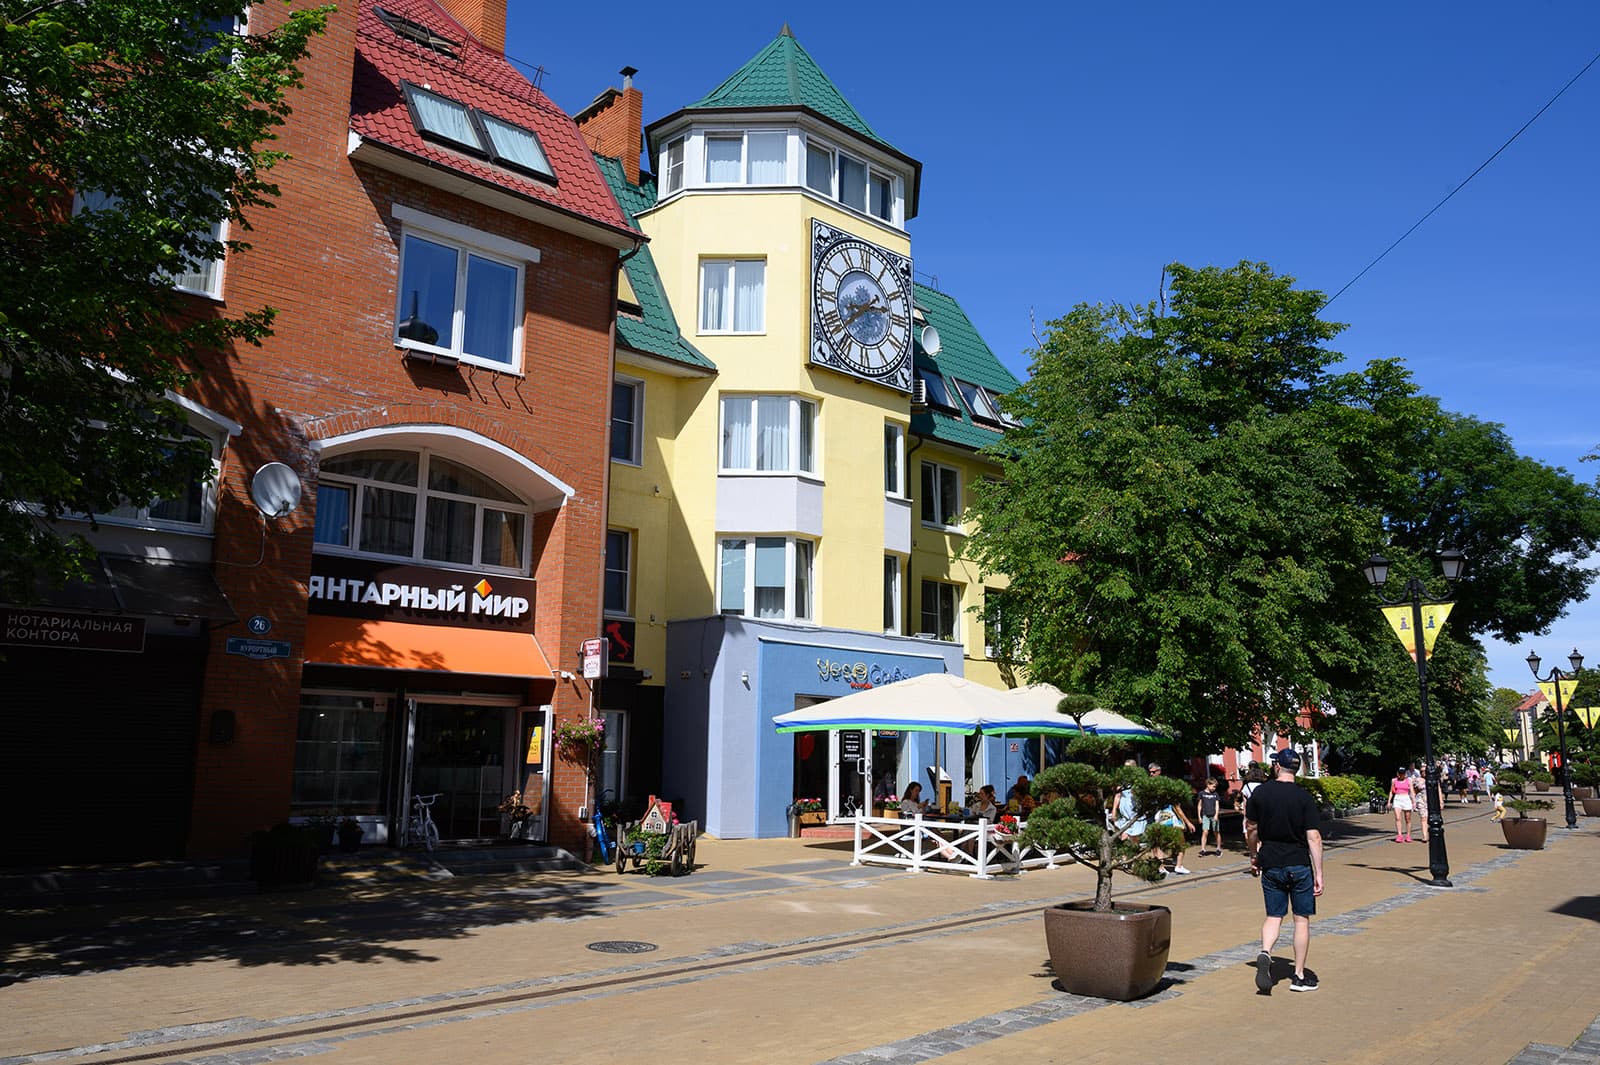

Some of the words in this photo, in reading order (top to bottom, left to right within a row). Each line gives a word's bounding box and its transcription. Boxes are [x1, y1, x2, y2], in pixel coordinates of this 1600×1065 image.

[309, 575, 466, 613] ЯНТАРНЫЙ
[471, 592, 529, 618] МИР
[7, 614, 134, 633] НОТАРИАЛЬНАЯ
[253, 619, 266, 631] 26
[6, 627, 80, 642] КОНТОРА
